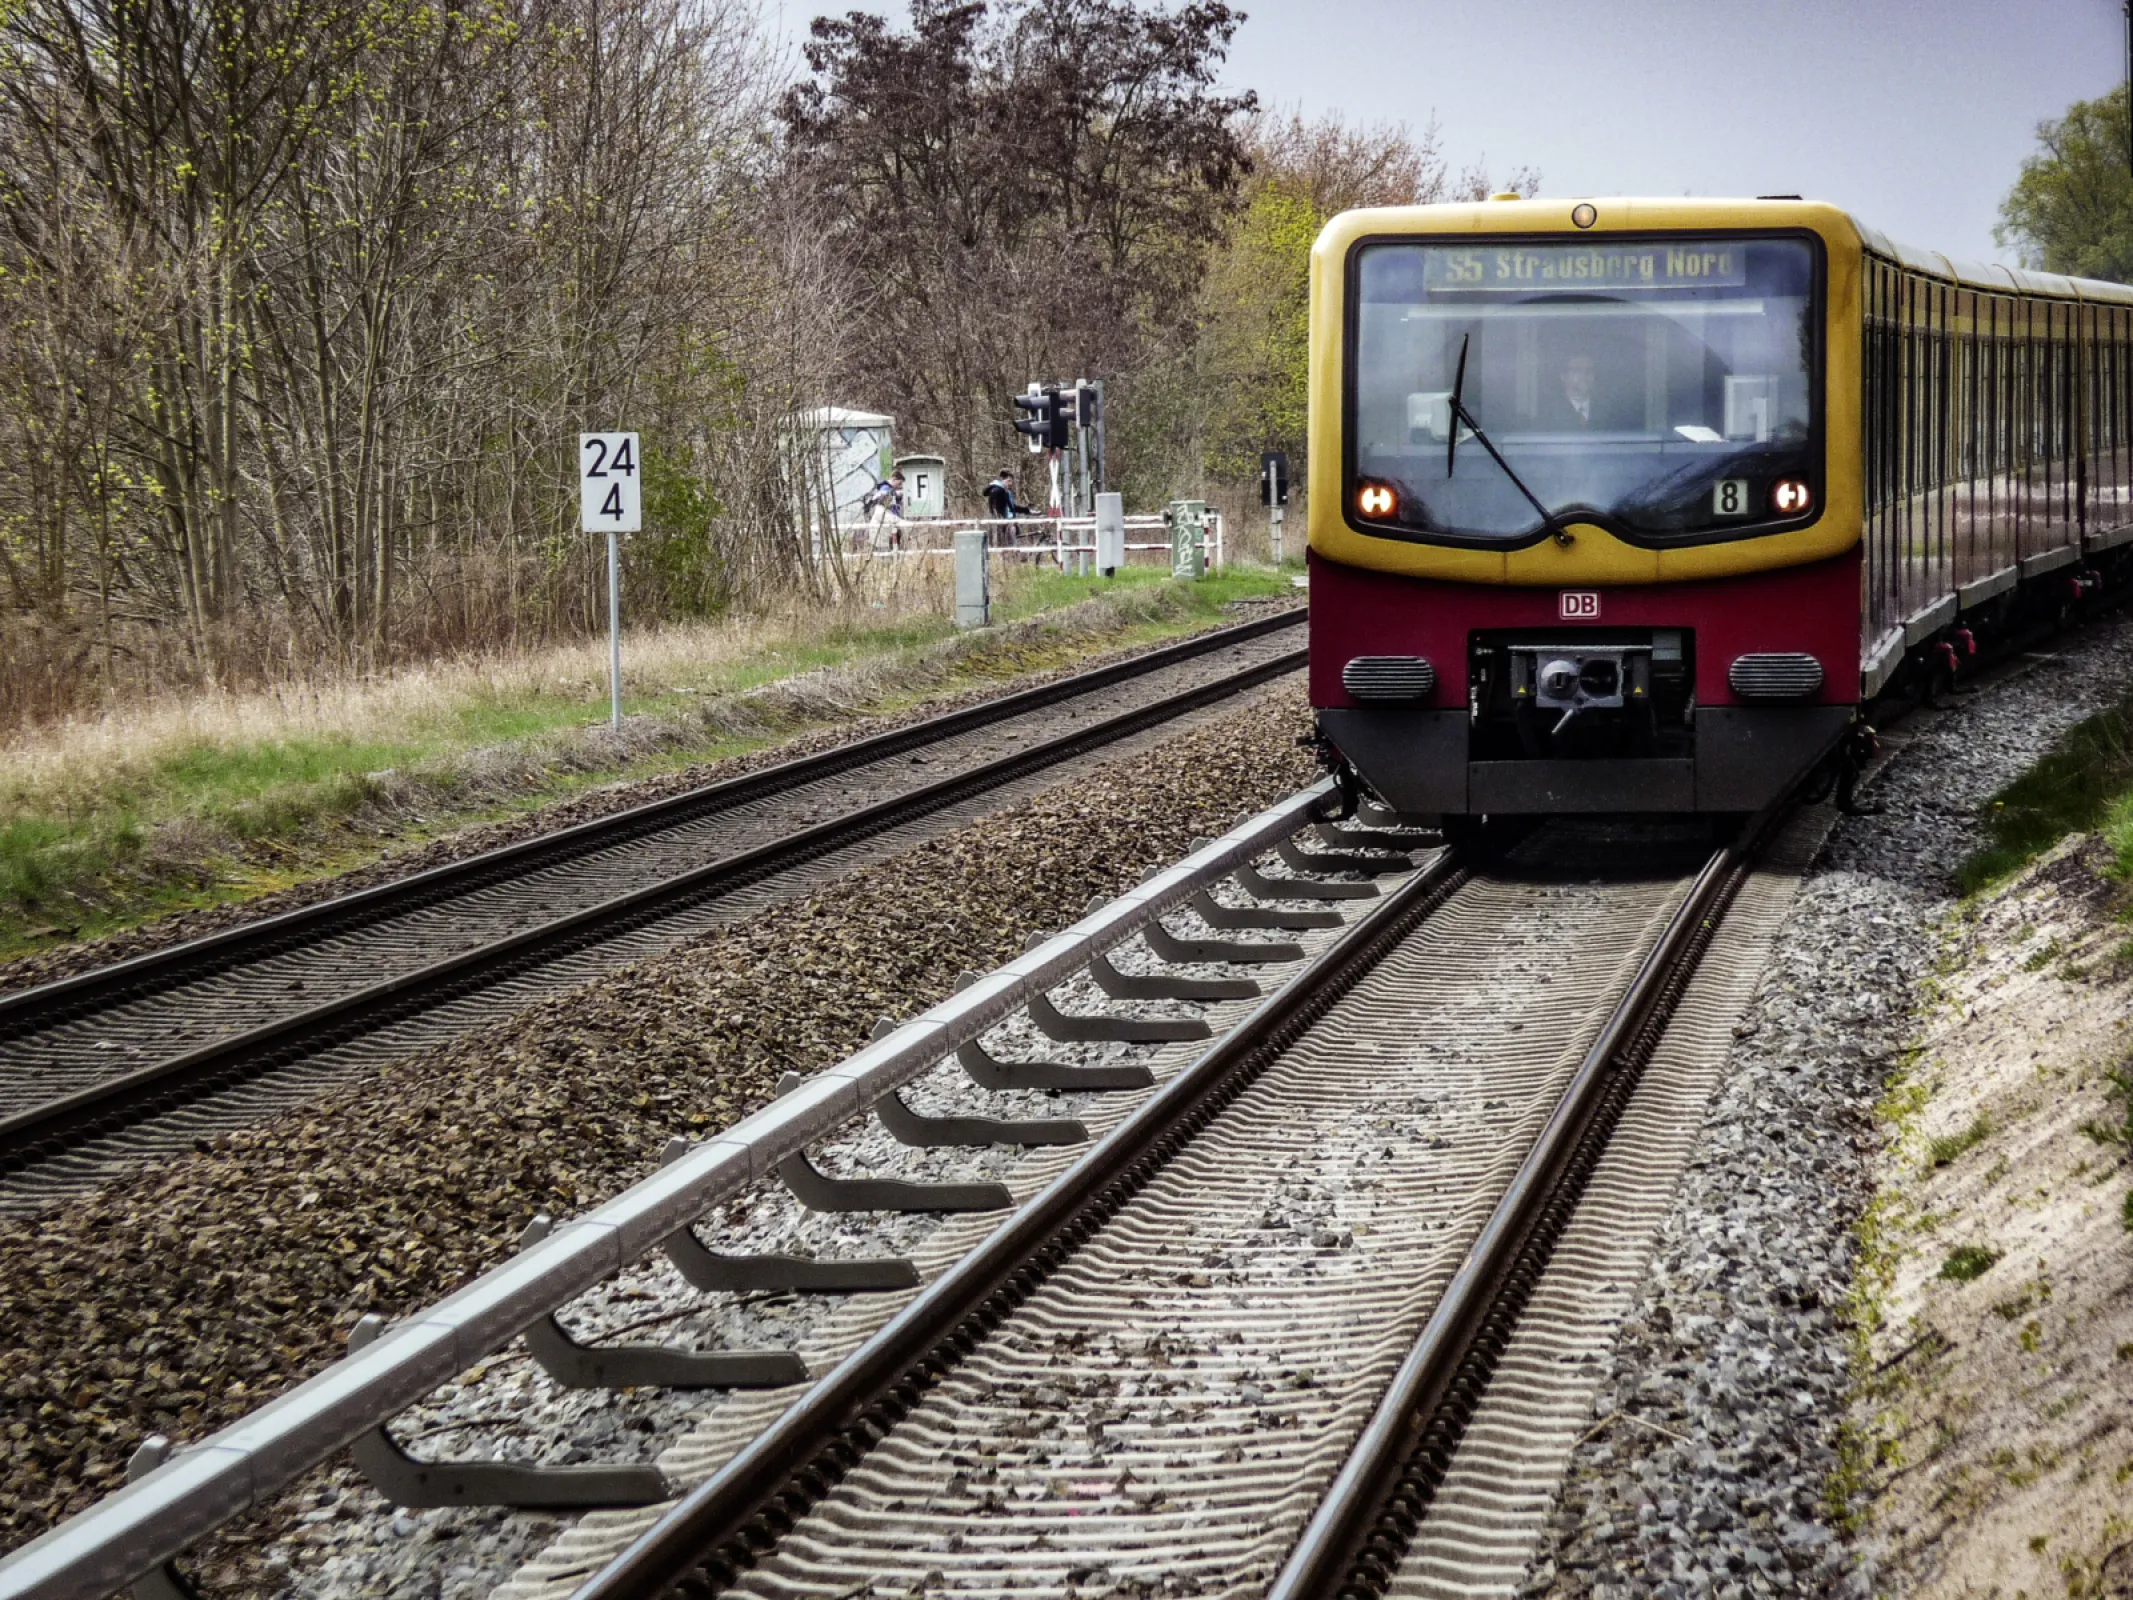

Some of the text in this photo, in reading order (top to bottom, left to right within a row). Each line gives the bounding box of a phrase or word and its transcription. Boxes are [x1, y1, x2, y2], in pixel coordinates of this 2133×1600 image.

[1447, 251, 1483, 281] S5
[1496, 249, 1654, 280] Strausberg
[584, 438, 635, 477] 24
[599, 482, 624, 521] 4
[916, 474, 928, 498] F
[1721, 482, 1738, 512] 8
[1564, 595, 1595, 614] DB
